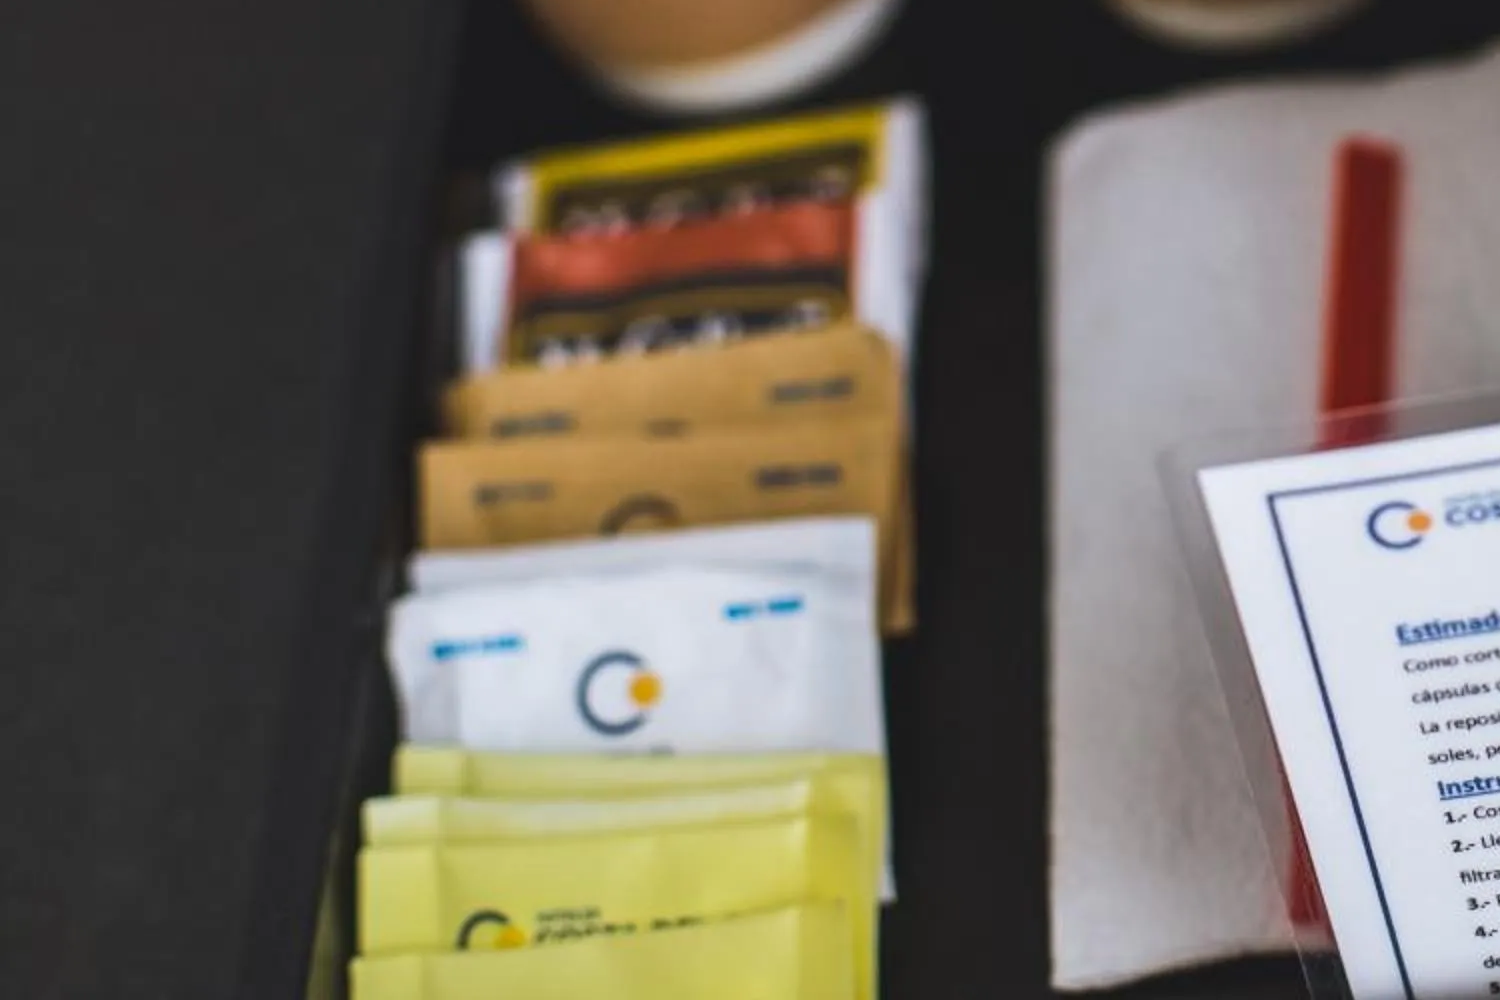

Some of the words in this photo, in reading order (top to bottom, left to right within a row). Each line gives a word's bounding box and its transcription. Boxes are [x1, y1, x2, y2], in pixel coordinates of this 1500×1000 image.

[1403, 656, 1459, 673] Como
[1411, 683, 1491, 704] cápsulas
[1419, 722, 1440, 735] La
[1443, 811, 1468, 825] 1.-
[1450, 839, 1476, 853] 2.-
[1466, 897, 1491, 911] 3.-
[1474, 925, 1498, 939] 4.-
